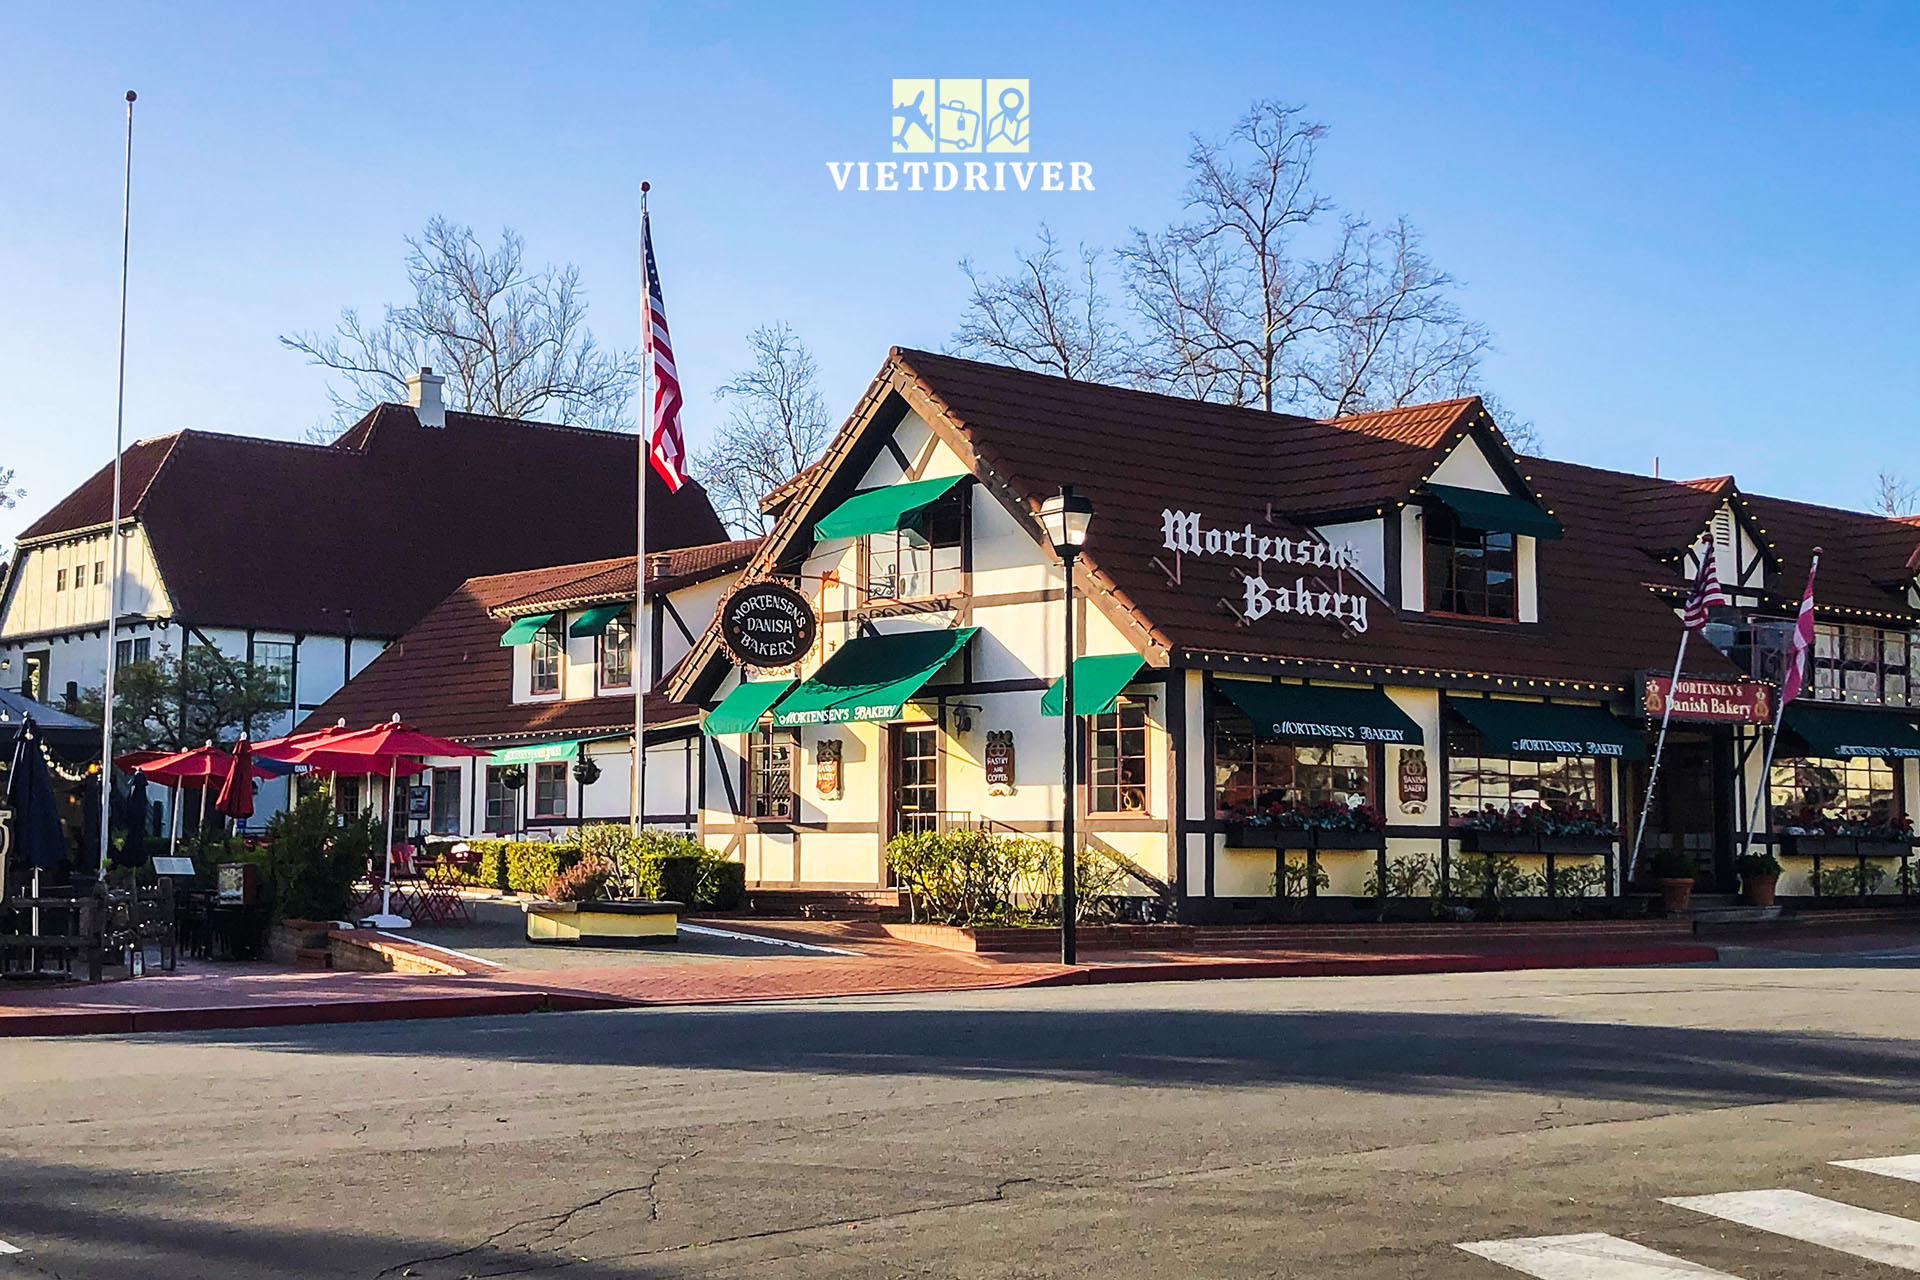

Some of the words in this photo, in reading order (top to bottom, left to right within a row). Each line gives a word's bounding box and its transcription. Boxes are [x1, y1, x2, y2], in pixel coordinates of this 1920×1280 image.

[731, 594, 807, 628] MORTENSEN'S
[1242, 575, 1368, 633] Bakery
[747, 617, 793, 634] DANISH
[740, 631, 796, 656] BAKERY
[1674, 681, 1743, 697] MORTENSEN'S
[779, 708, 850, 725] MORTENSEN'S
[854, 705, 896, 721] BAKERY
[1711, 698, 1752, 719] Bakery
[1272, 720, 1356, 738] MORTENSEN'S
[1359, 726, 1405, 741] BAKERY
[1512, 738, 1583, 753] MORTENSEN'S
[1585, 742, 1624, 756] BAKERY
[987, 757, 1009, 765] PASTRY
